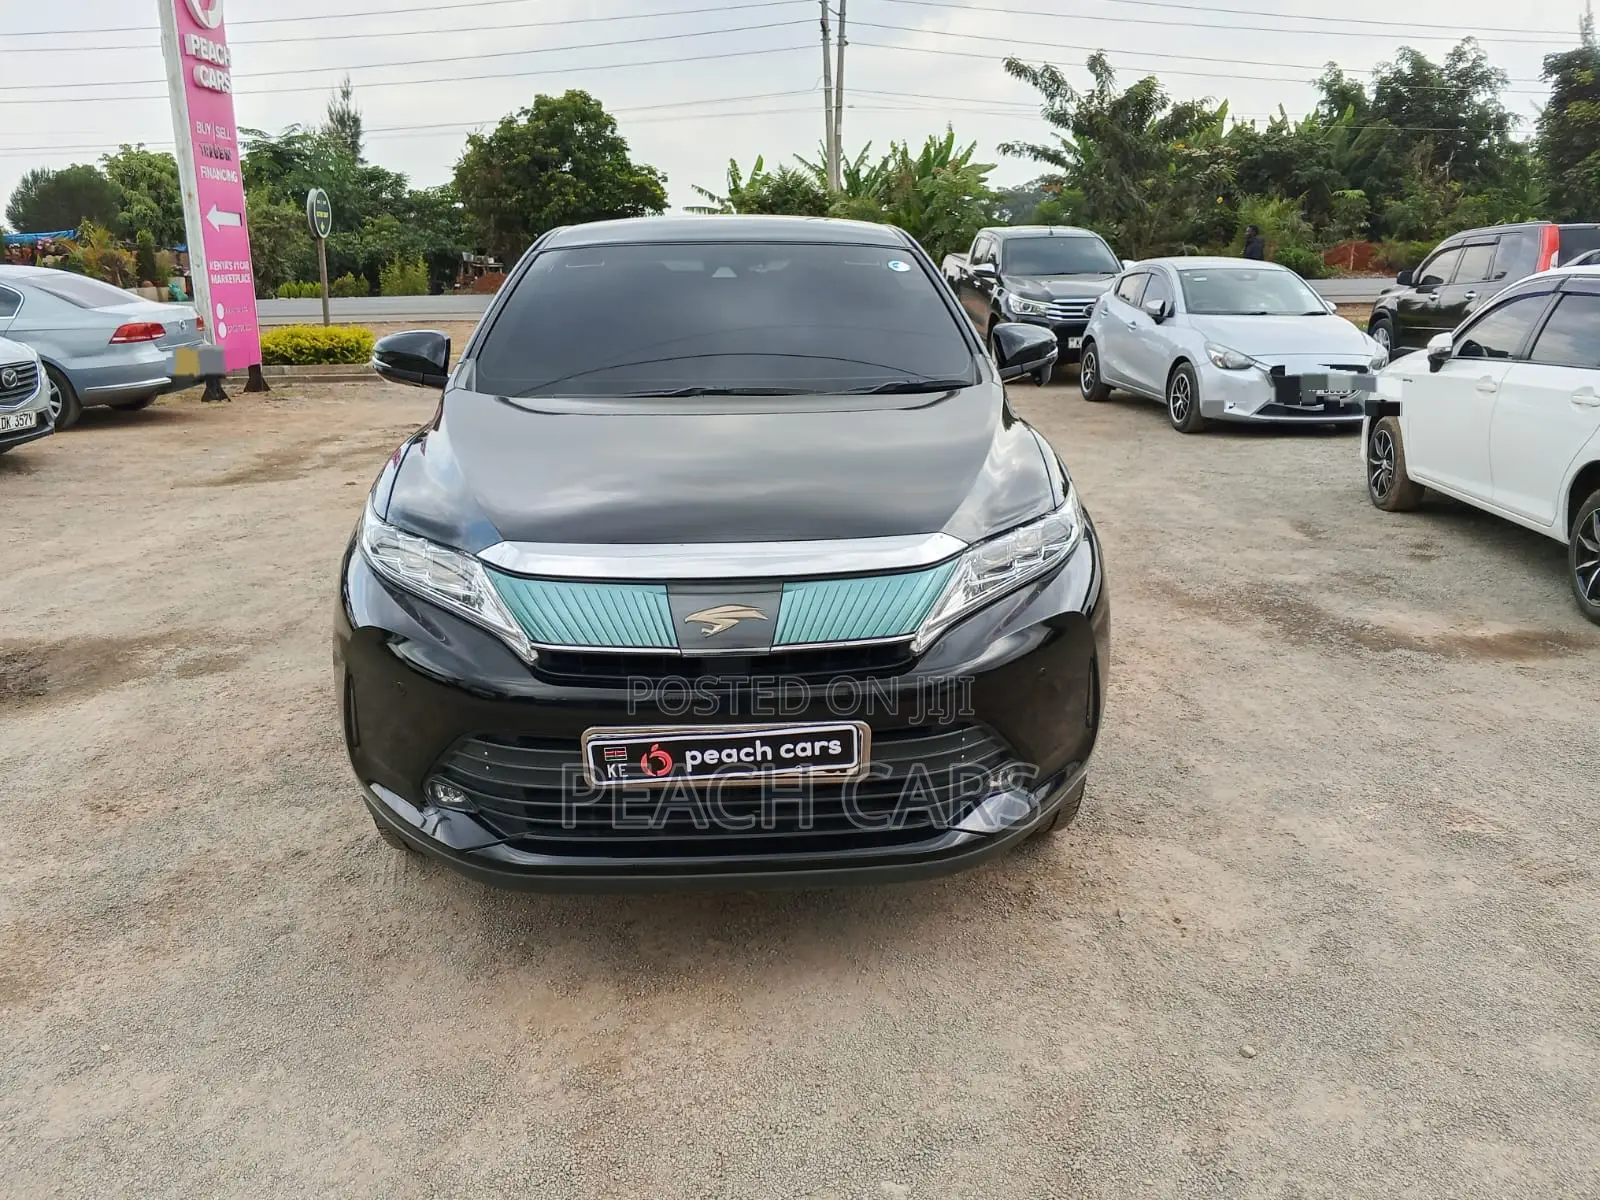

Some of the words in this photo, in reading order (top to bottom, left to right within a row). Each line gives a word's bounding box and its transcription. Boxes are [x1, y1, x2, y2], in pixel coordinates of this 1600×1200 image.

[186, 34, 231, 67] PEACH
[195, 65, 232, 93] CARS
[200, 165, 238, 184] FINANCING
[211, 273, 251, 284] MARKETPLACE
[15, 413, 33, 427] 357Y
[684, 740, 772, 772] peach
[779, 740, 842, 759] cars
[607, 763, 628, 778] KE
